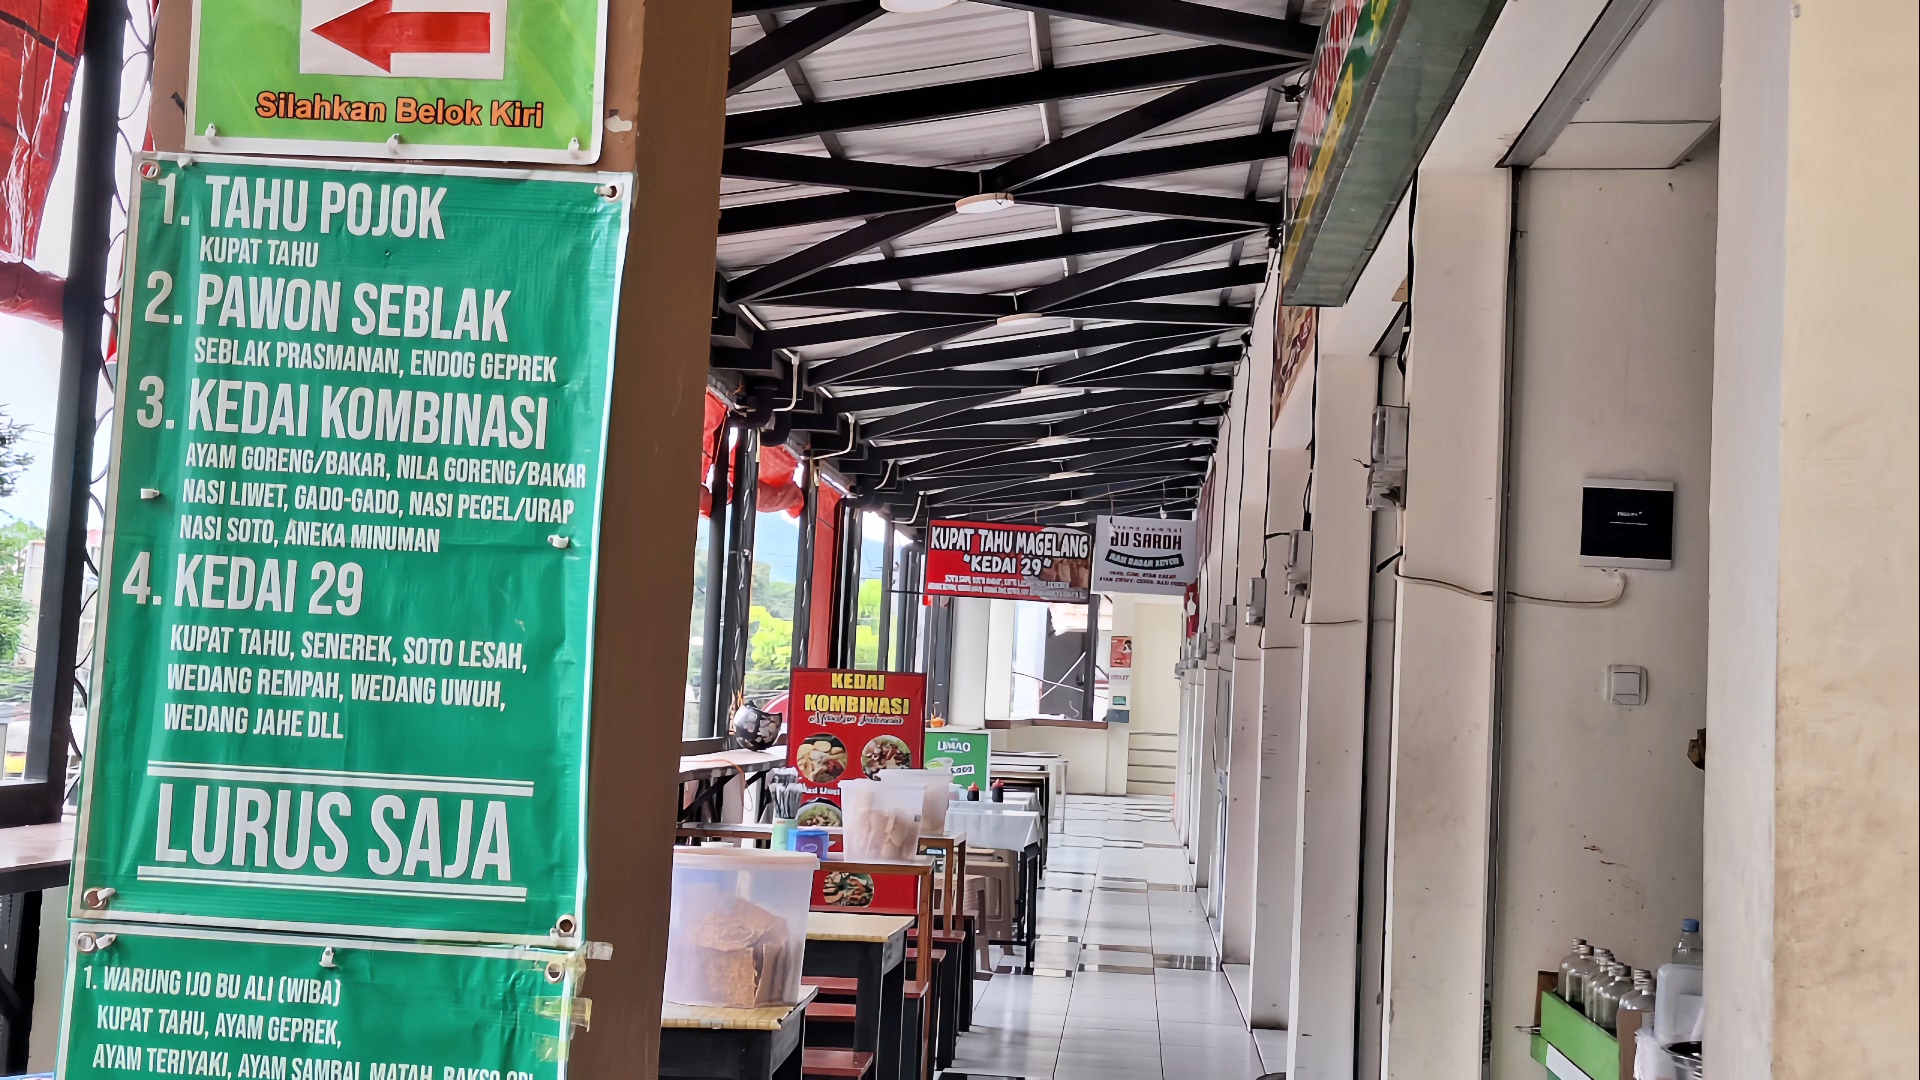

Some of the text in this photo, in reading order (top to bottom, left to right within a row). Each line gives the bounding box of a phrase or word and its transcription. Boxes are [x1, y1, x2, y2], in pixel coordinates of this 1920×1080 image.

[255, 91, 544, 128] Silahkan Belok Kiri
[158, 173, 447, 239] 1. TAHU POJOK
[200, 236, 318, 267] KUPAT TAHU
[145, 271, 511, 342] 2. PAWON SEBLAK
[194, 337, 557, 382] SEBLAK PRASMANAN, ENDOG GEPREK
[137, 376, 548, 449] 3. KEDAI KOMBINASI
[186, 442, 586, 488] AYAM GORENG/BAKAR, NILA GORENG/BAKAR
[183, 478, 574, 524] NASI LIWET, GADO-GADO, NASI PECEL/URAP
[180, 515, 440, 552] NASI SOTO, ANEKA MINUMAN
[931, 526, 1090, 558] KUPAT TAHU MAGELANG
[123, 553, 363, 616] 4. KEDAI 29
[171, 624, 526, 673] KUPAT TAHU, SENEREK, SOTO LESAH,
[168, 664, 505, 711] WEDANG REMPAH, WEDANG UWUH,
[831, 673, 885, 690] KEDAI
[165, 703, 343, 738] WEDANG JAHE DLL
[805, 694, 910, 714] KOMBINASI
[155, 783, 511, 881] LURUS SAJA
[84, 965, 341, 1006] 1. WARUNG IJO BU ALI (WIBA)
[98, 1005, 341, 1048] KUPAT TAHU, AYAM GEPREK,
[93, 1044, 141, 1074] AYAM
[147, 1048, 231, 1080] TERIYAKI,
[238, 1054, 286, 1080] AYAM
